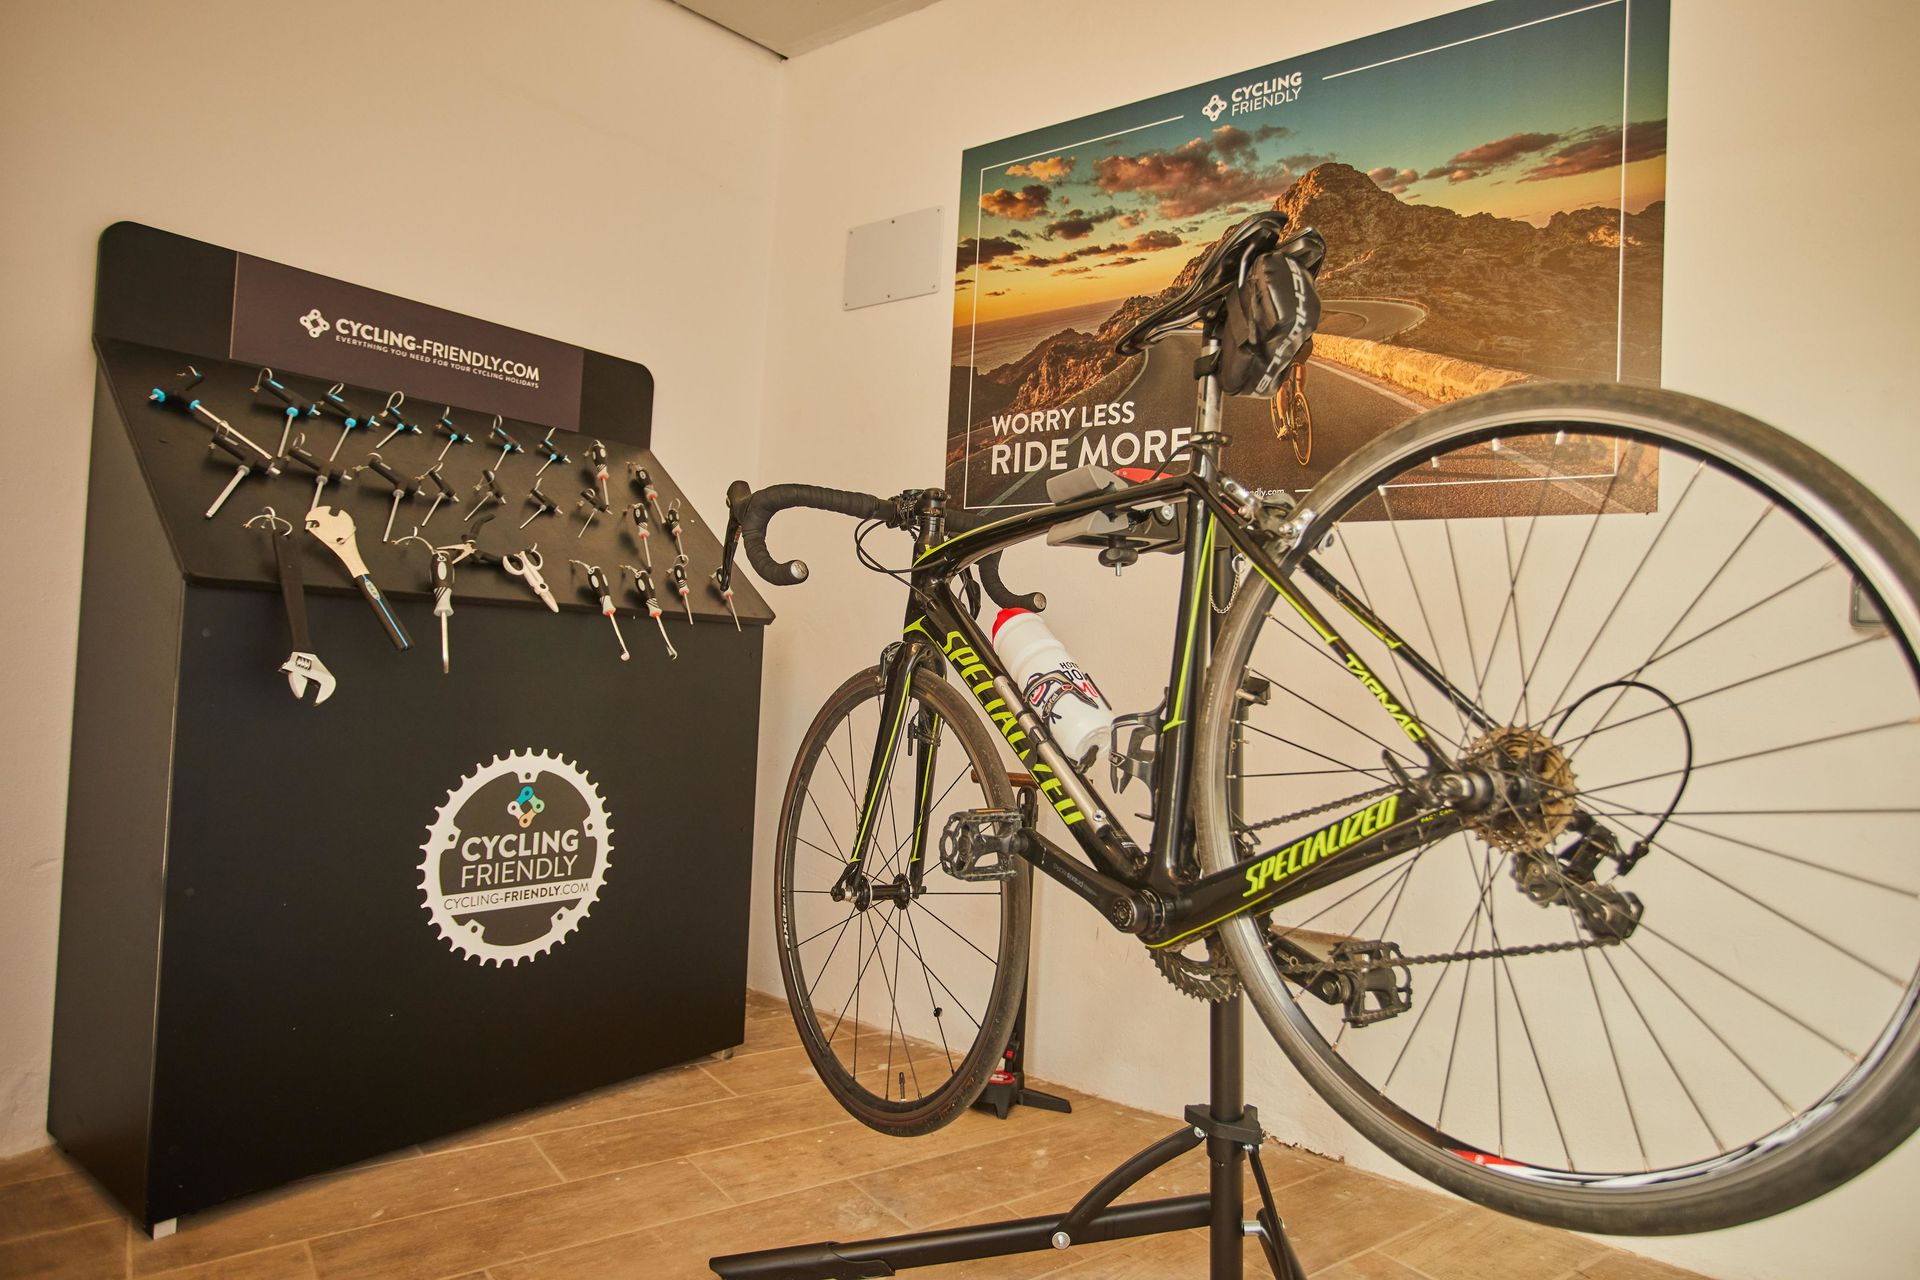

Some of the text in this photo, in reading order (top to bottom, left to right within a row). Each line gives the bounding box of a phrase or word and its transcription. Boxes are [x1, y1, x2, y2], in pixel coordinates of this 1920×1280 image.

[1231, 72, 1302, 102] CYCLING
[1231, 86, 1302, 117] FRIENDLY
[335, 318, 540, 382] CYCLING-FRIENDLY.COM
[335, 335, 540, 389] EVERYTHING YOU NEED FOR YOUR CYCLING HOLIDAYS
[991, 401, 1135, 437] WORRY LESS
[991, 427, 1192, 475] RIDE MORE
[1345, 653, 1426, 743] TARMAC
[461, 829, 579, 862] CYCLING
[1242, 795, 1399, 897] SPECIALIZED
[461, 854, 578, 888] FRIENDLY
[444, 882, 589, 911] CYCLING-FRIENDLY.COM
